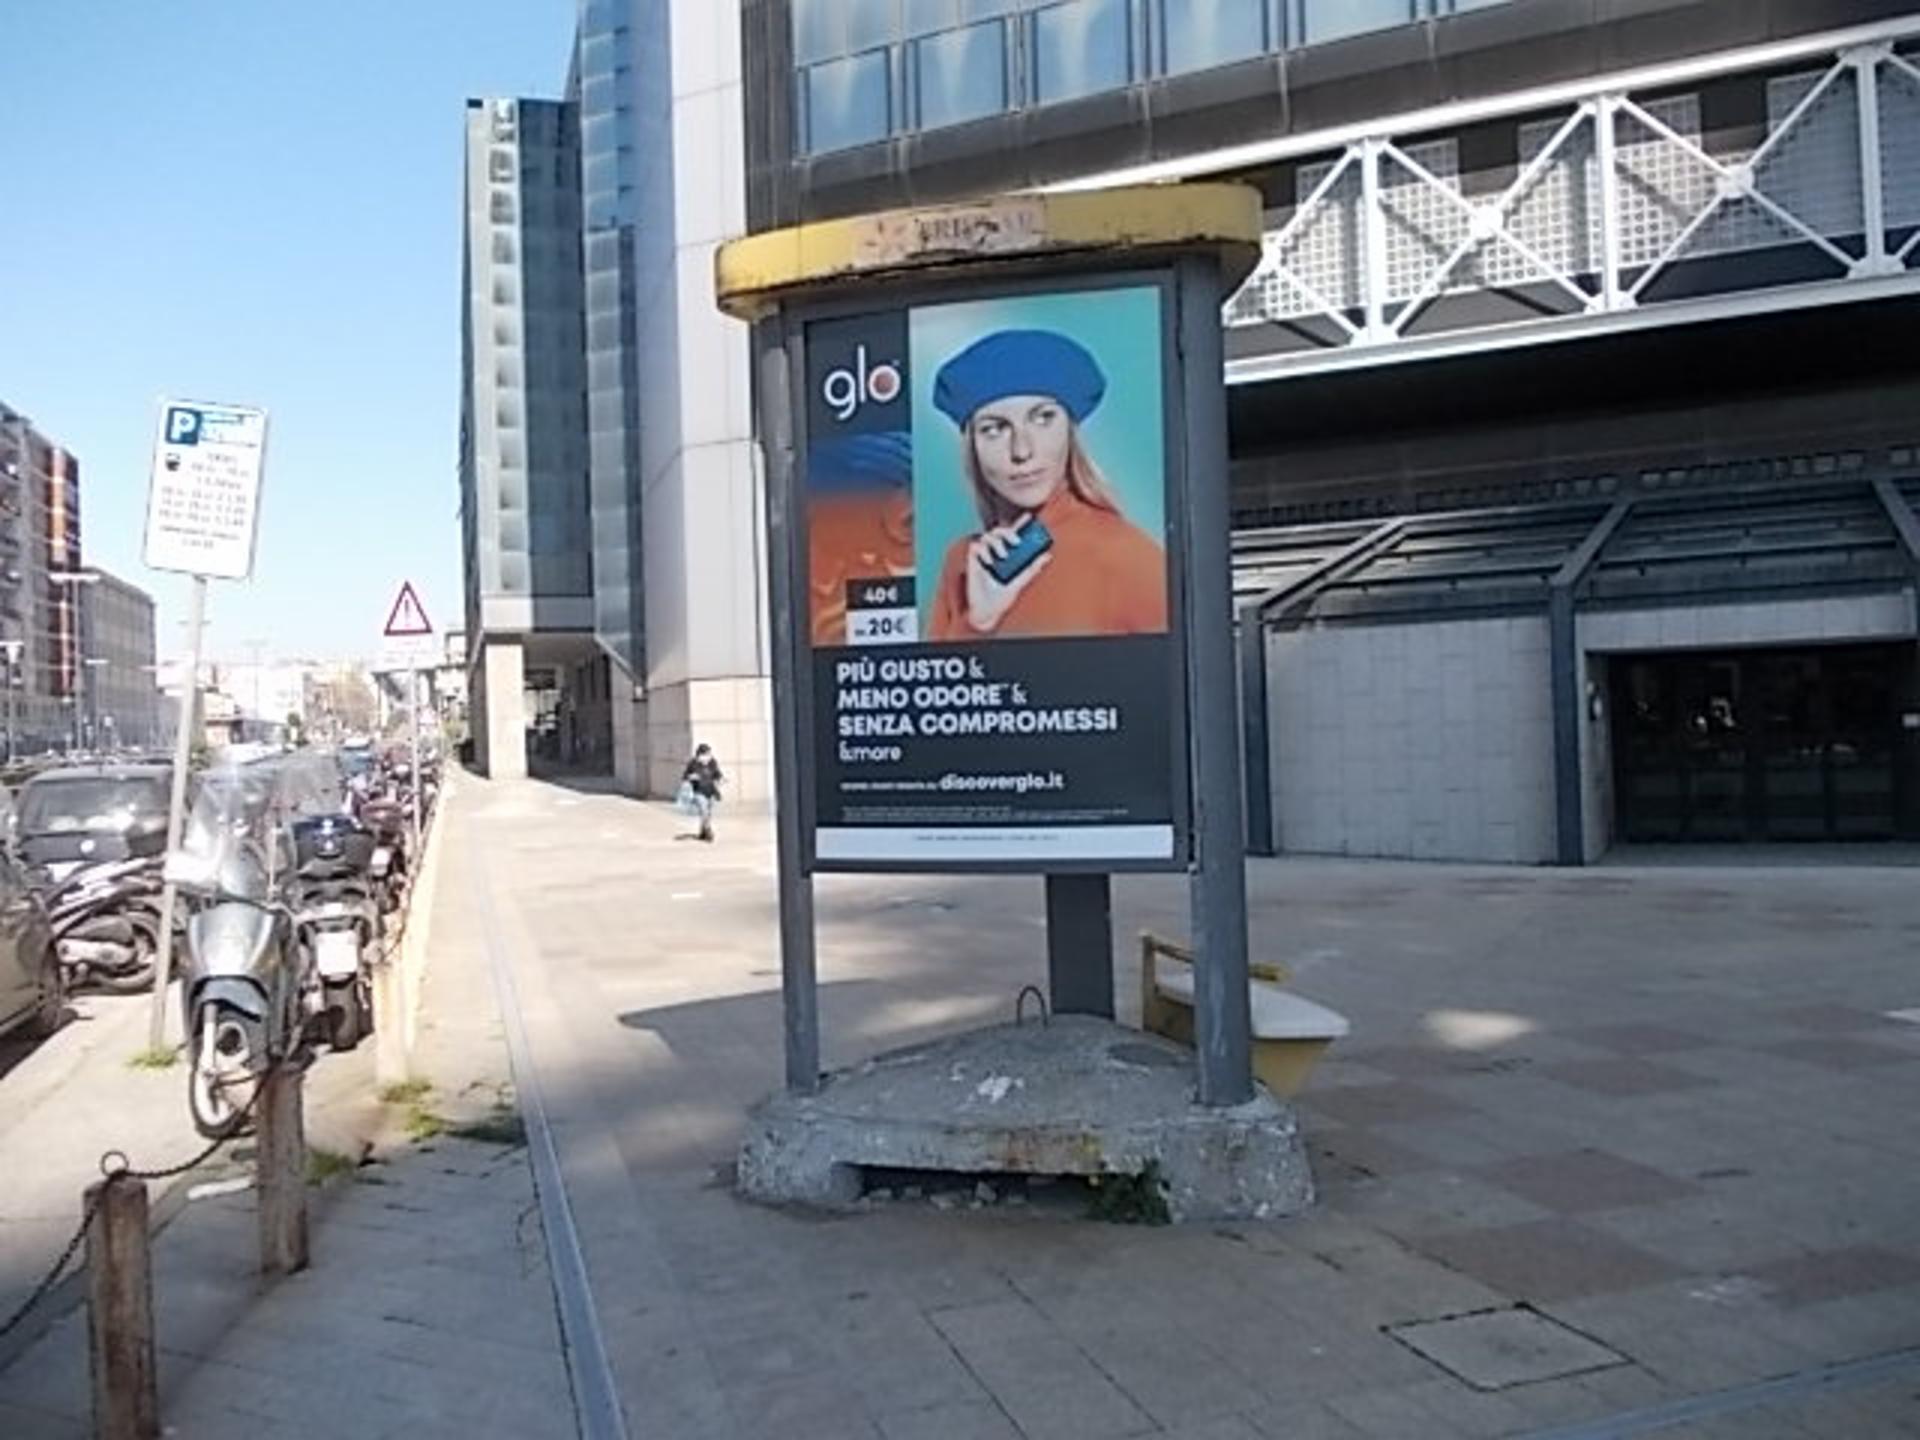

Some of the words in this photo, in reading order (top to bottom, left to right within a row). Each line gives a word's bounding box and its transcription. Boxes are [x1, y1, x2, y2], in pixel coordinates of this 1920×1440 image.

[824, 344, 901, 421] glo
[837, 656, 875, 684] PIÙ
[880, 658, 965, 682] GUSTO
[838, 686, 909, 709] MENO
[839, 713, 915, 736] SENZA
[919, 707, 1117, 735] COMPROMESSI
